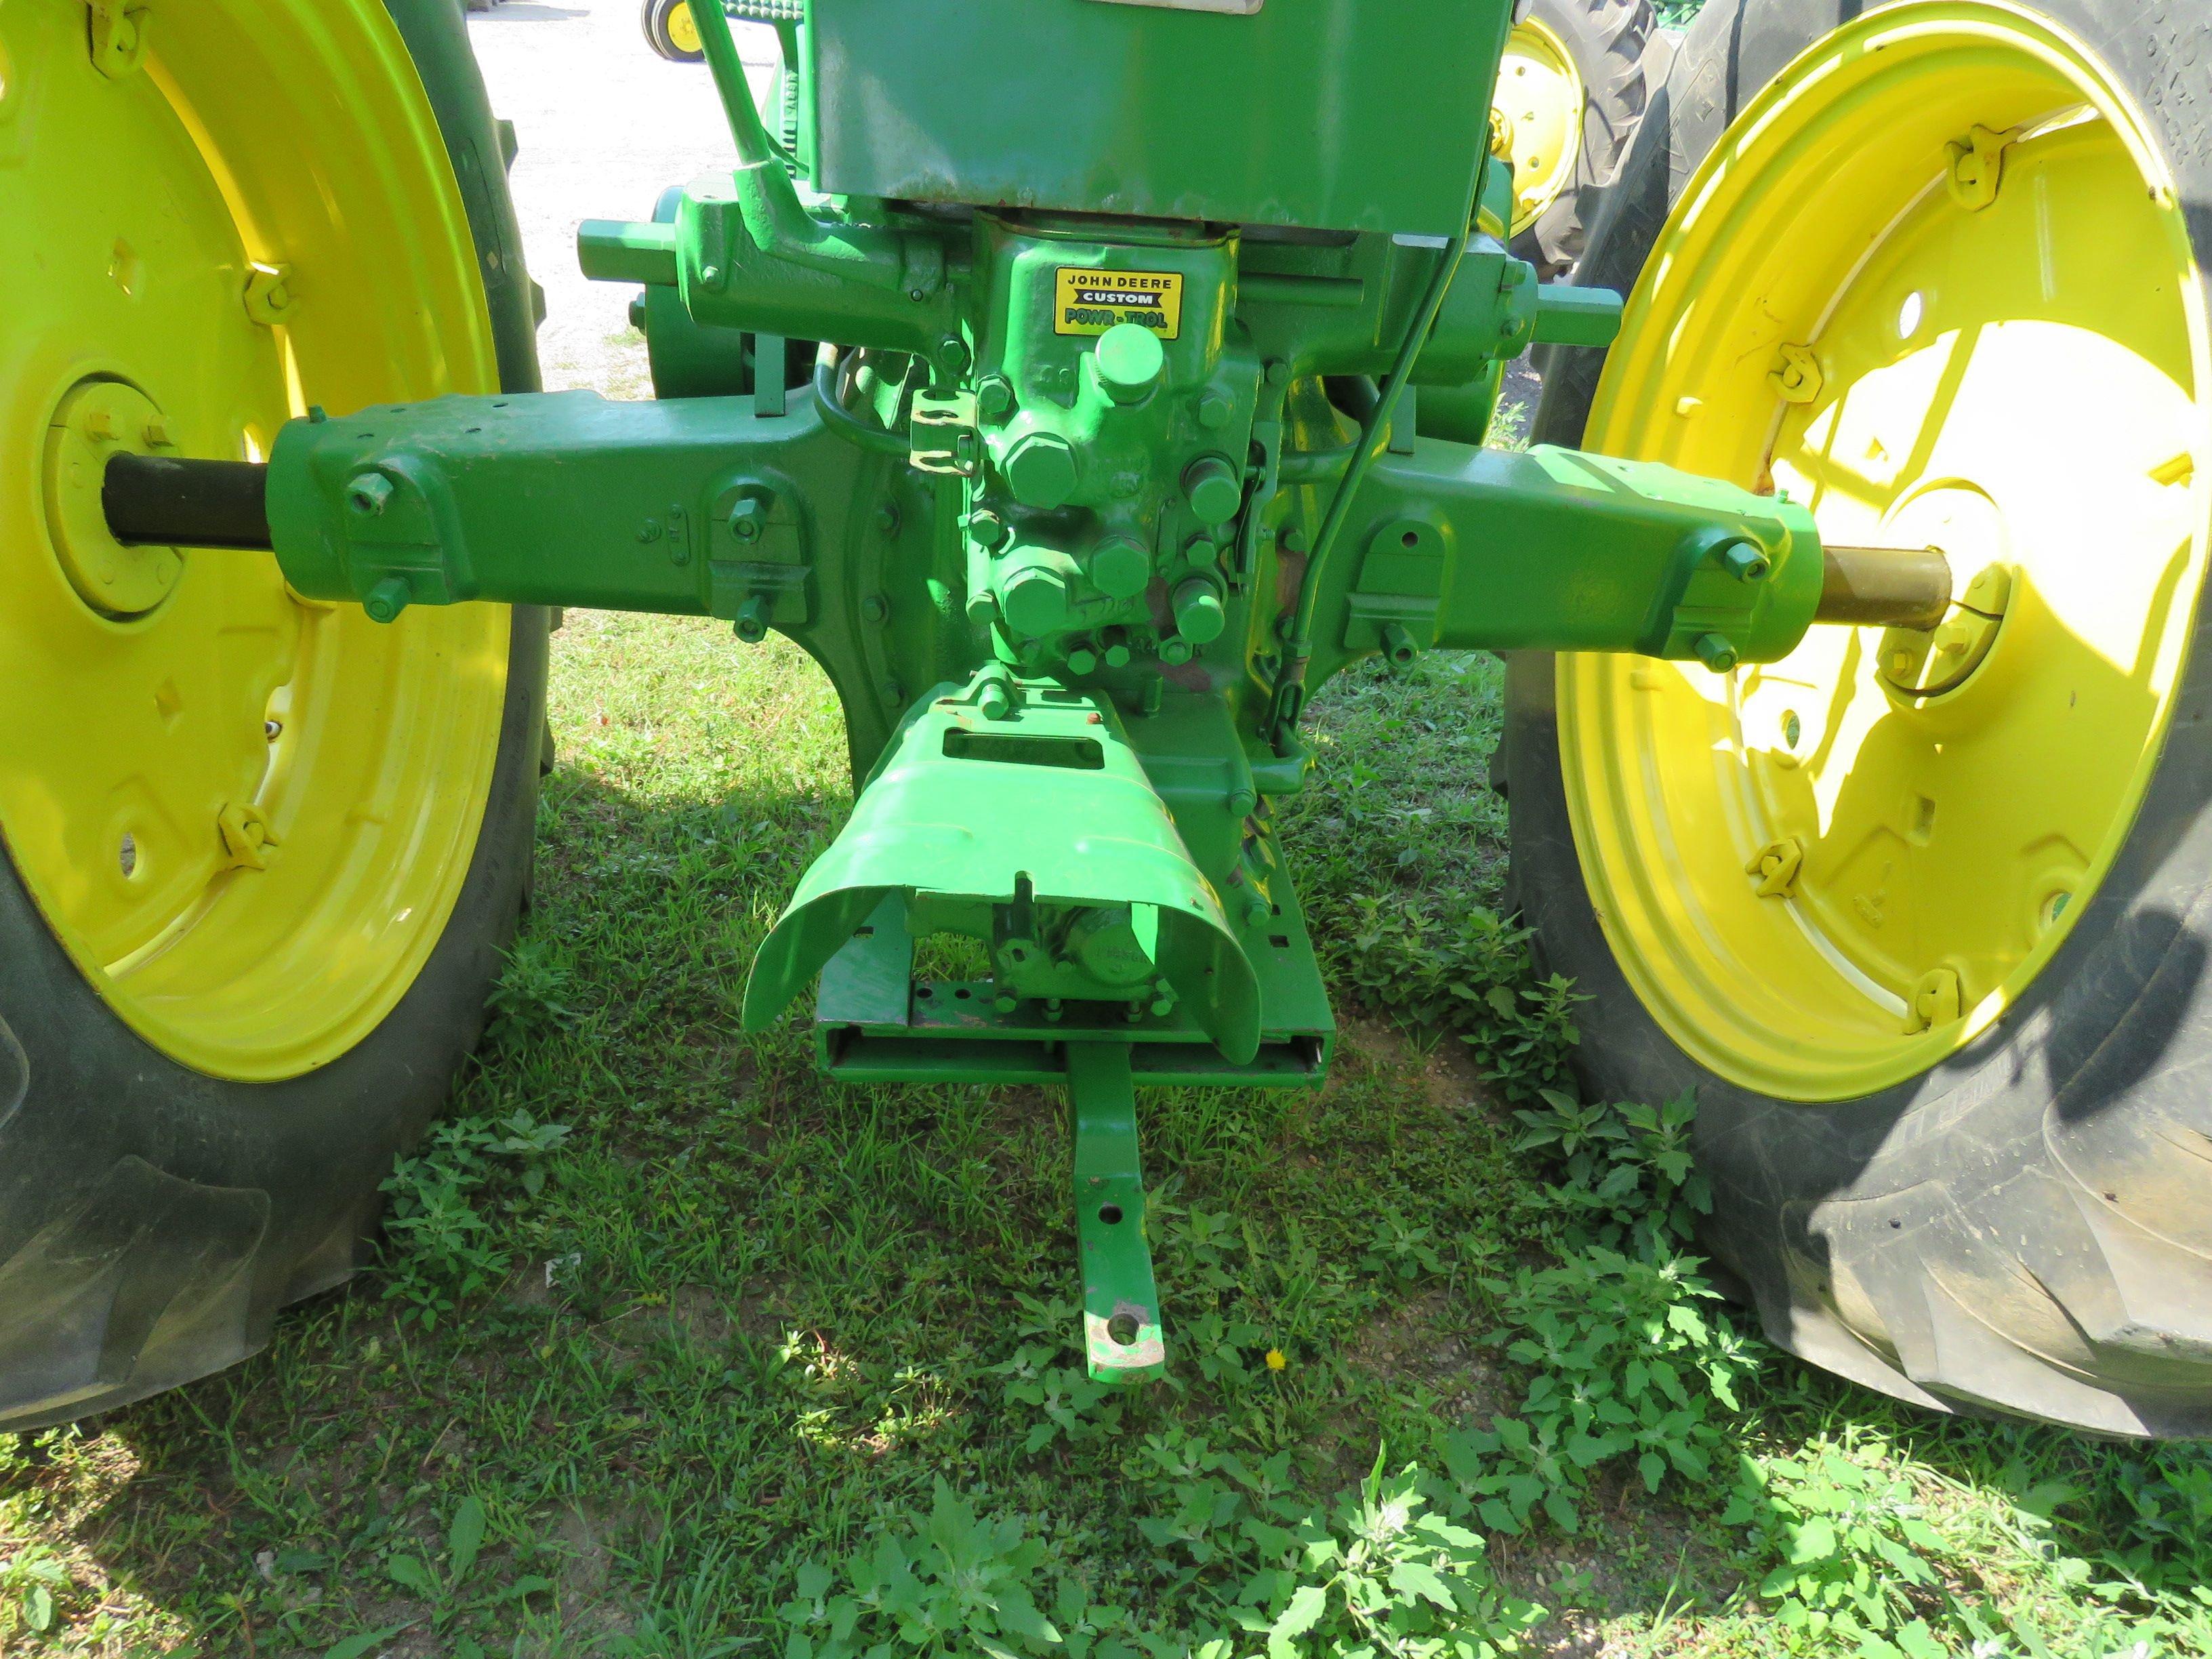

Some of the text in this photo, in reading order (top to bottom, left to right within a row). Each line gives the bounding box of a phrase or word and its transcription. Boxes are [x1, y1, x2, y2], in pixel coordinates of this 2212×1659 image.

[1067, 275, 1172, 289] JOHN DEERE
[1082, 292, 1153, 304] CUSTOM
